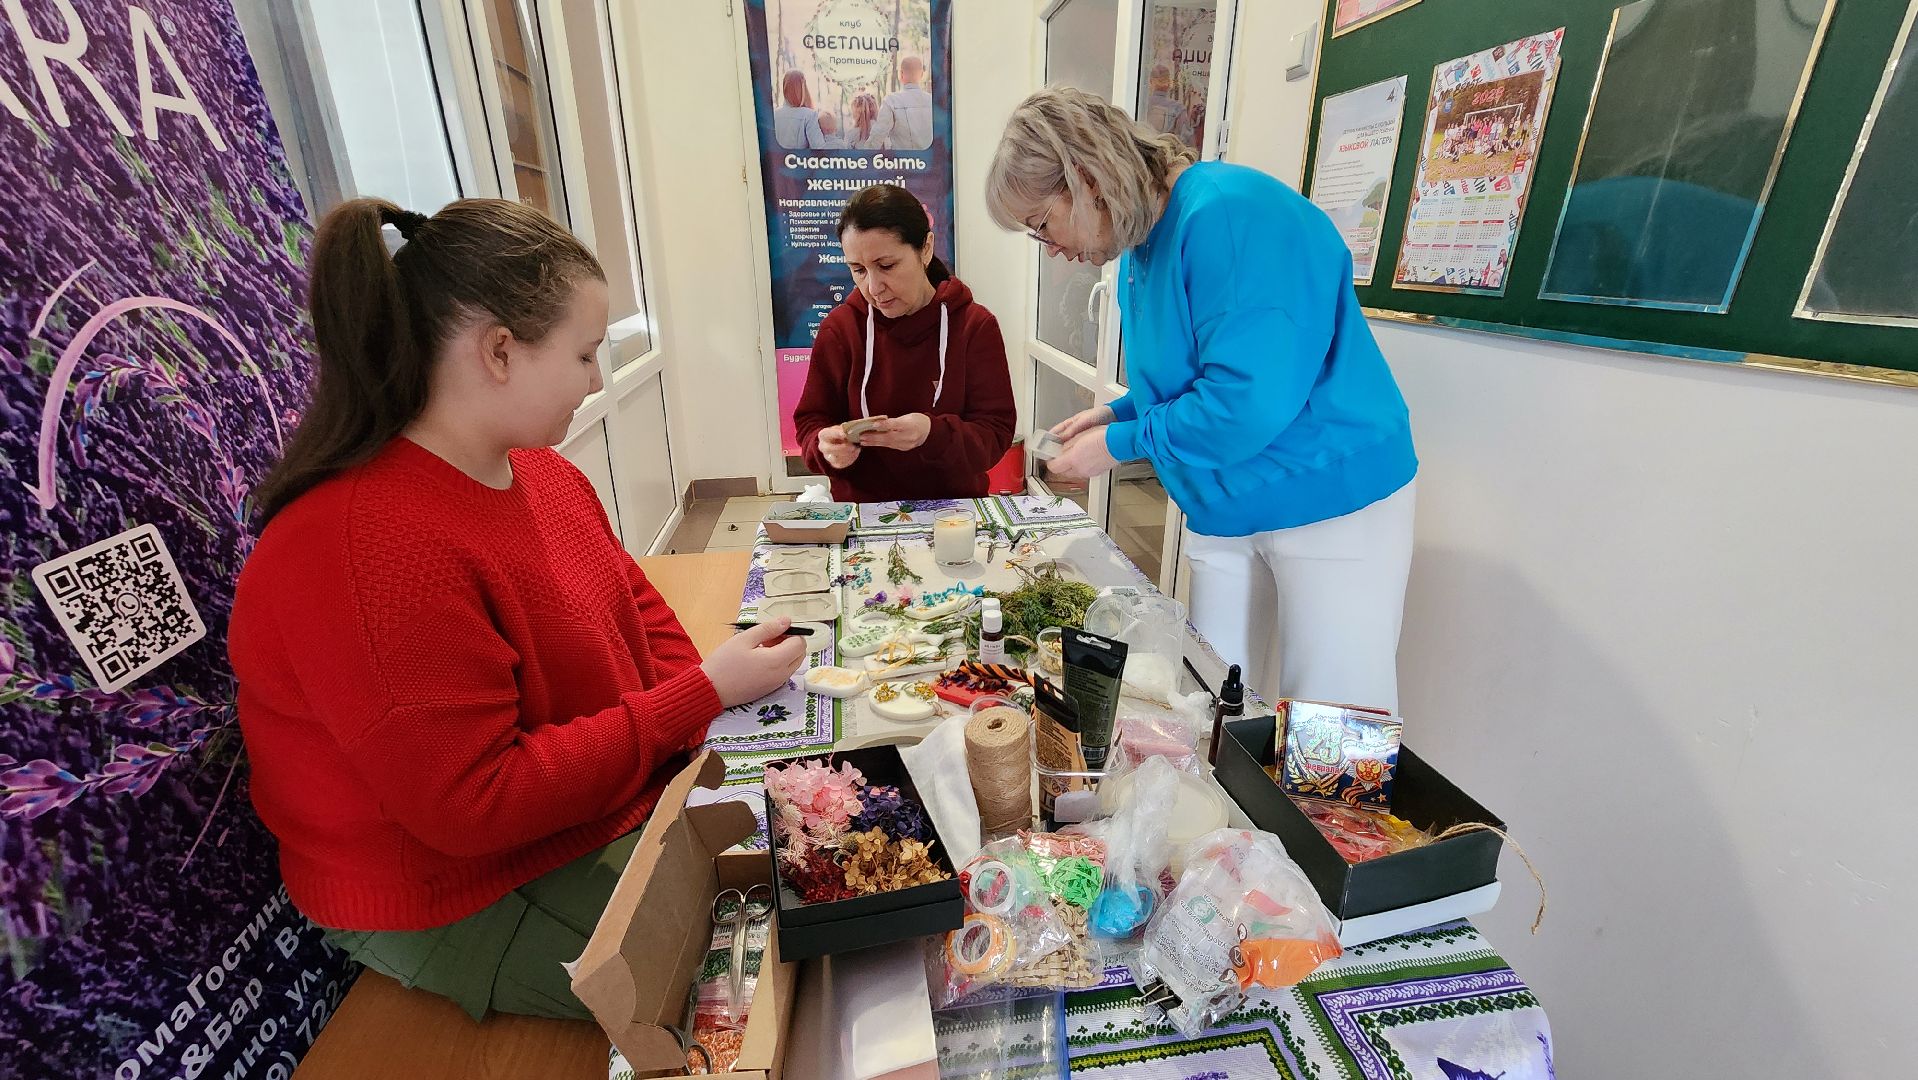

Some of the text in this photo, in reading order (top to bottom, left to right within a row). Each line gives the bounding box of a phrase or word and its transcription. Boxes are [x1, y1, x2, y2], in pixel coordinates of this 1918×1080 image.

[839, 19, 862, 29] клуб
[802, 34, 900, 53] СВЕТЛИЦА
[829, 56, 878, 66] Протвино
[784, 153, 926, 170] Счастье быть
[788, 210, 820, 218] Здоровье
[284, 967, 323, 1012] ул.
